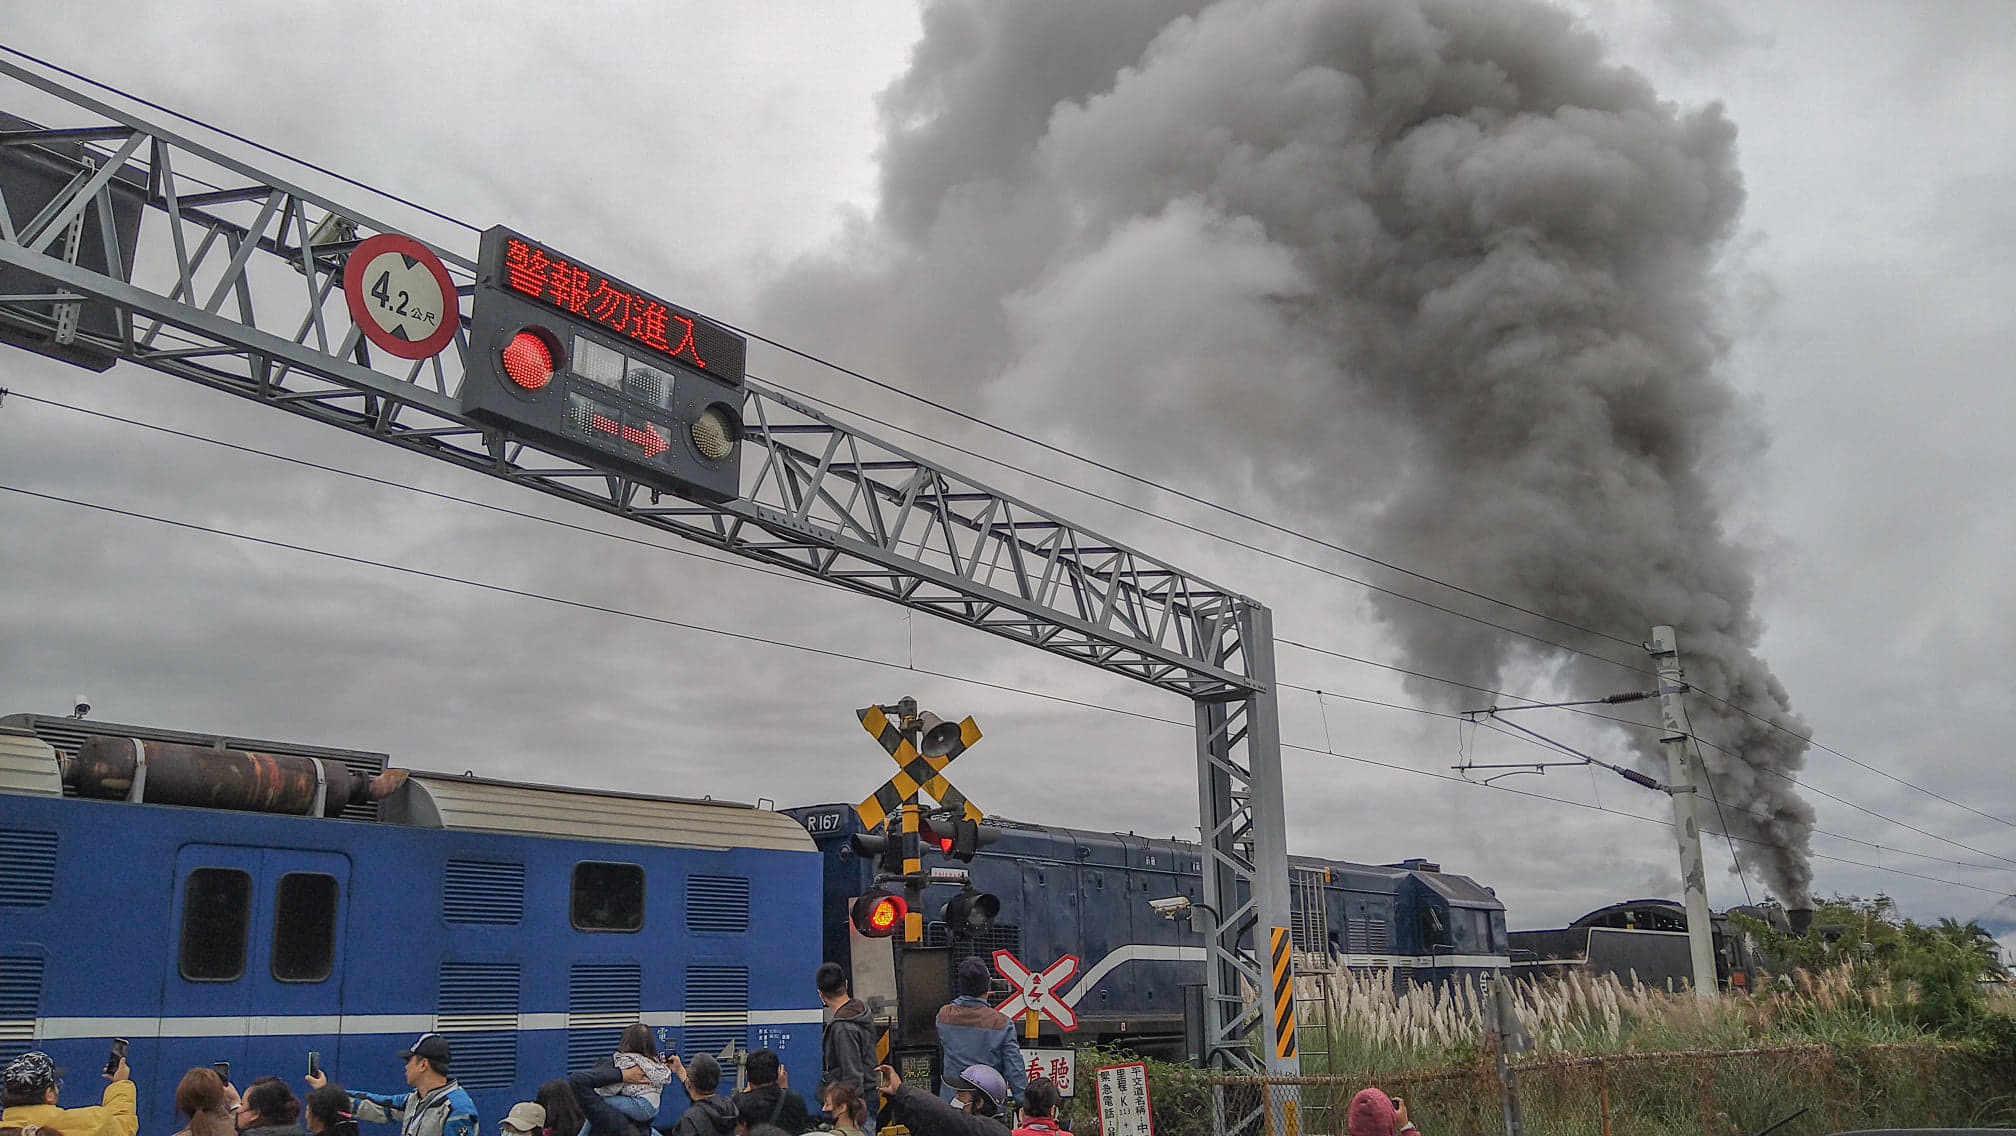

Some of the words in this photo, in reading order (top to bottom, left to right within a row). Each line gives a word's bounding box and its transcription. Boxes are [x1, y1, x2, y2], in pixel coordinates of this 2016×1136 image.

[505, 238, 706, 368] 警報勿進入
